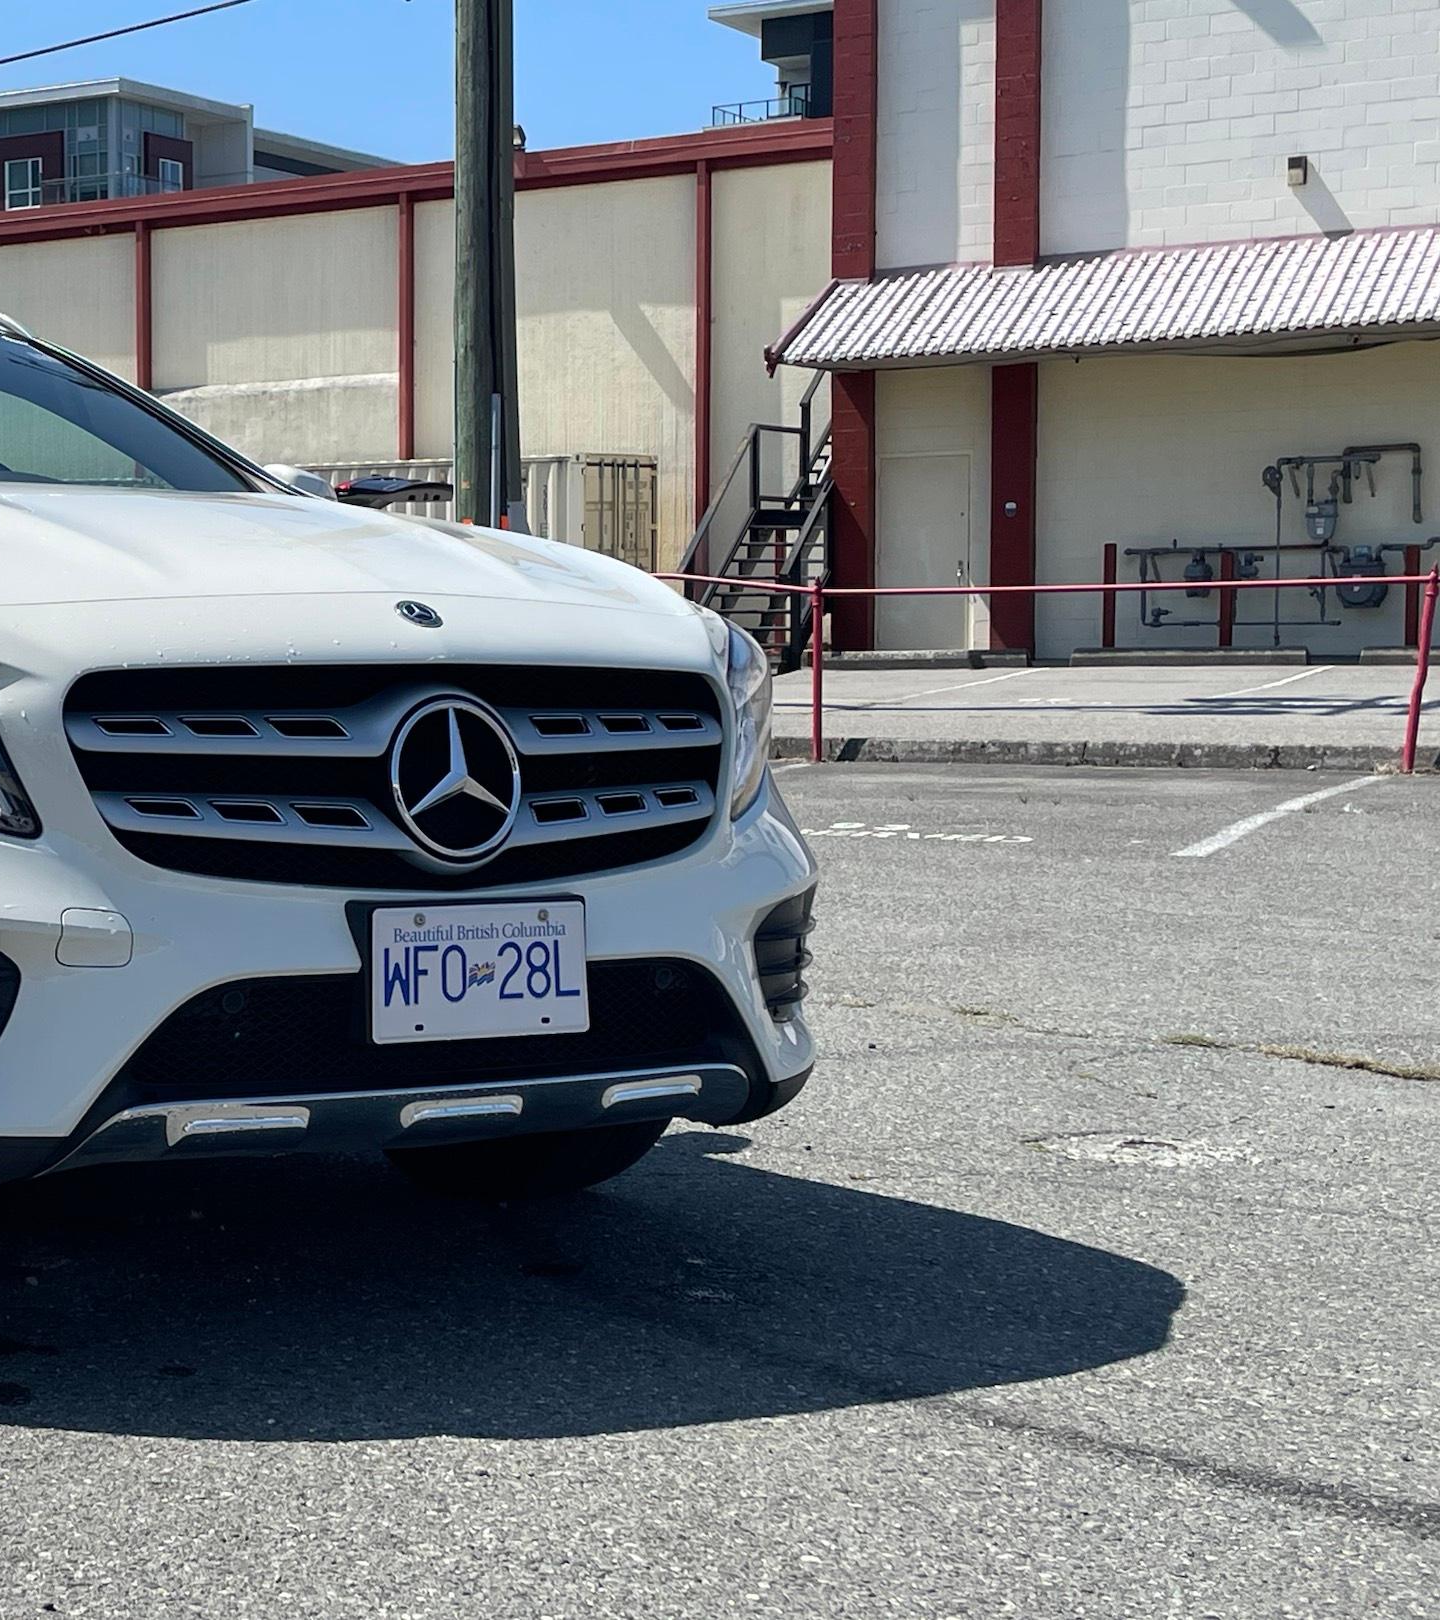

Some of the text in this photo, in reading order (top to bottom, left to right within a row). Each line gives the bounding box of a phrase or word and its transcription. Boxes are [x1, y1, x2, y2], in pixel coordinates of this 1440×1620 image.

[393, 920, 566, 944] Beautiful British Columbia
[497, 939, 581, 1000] 28L
